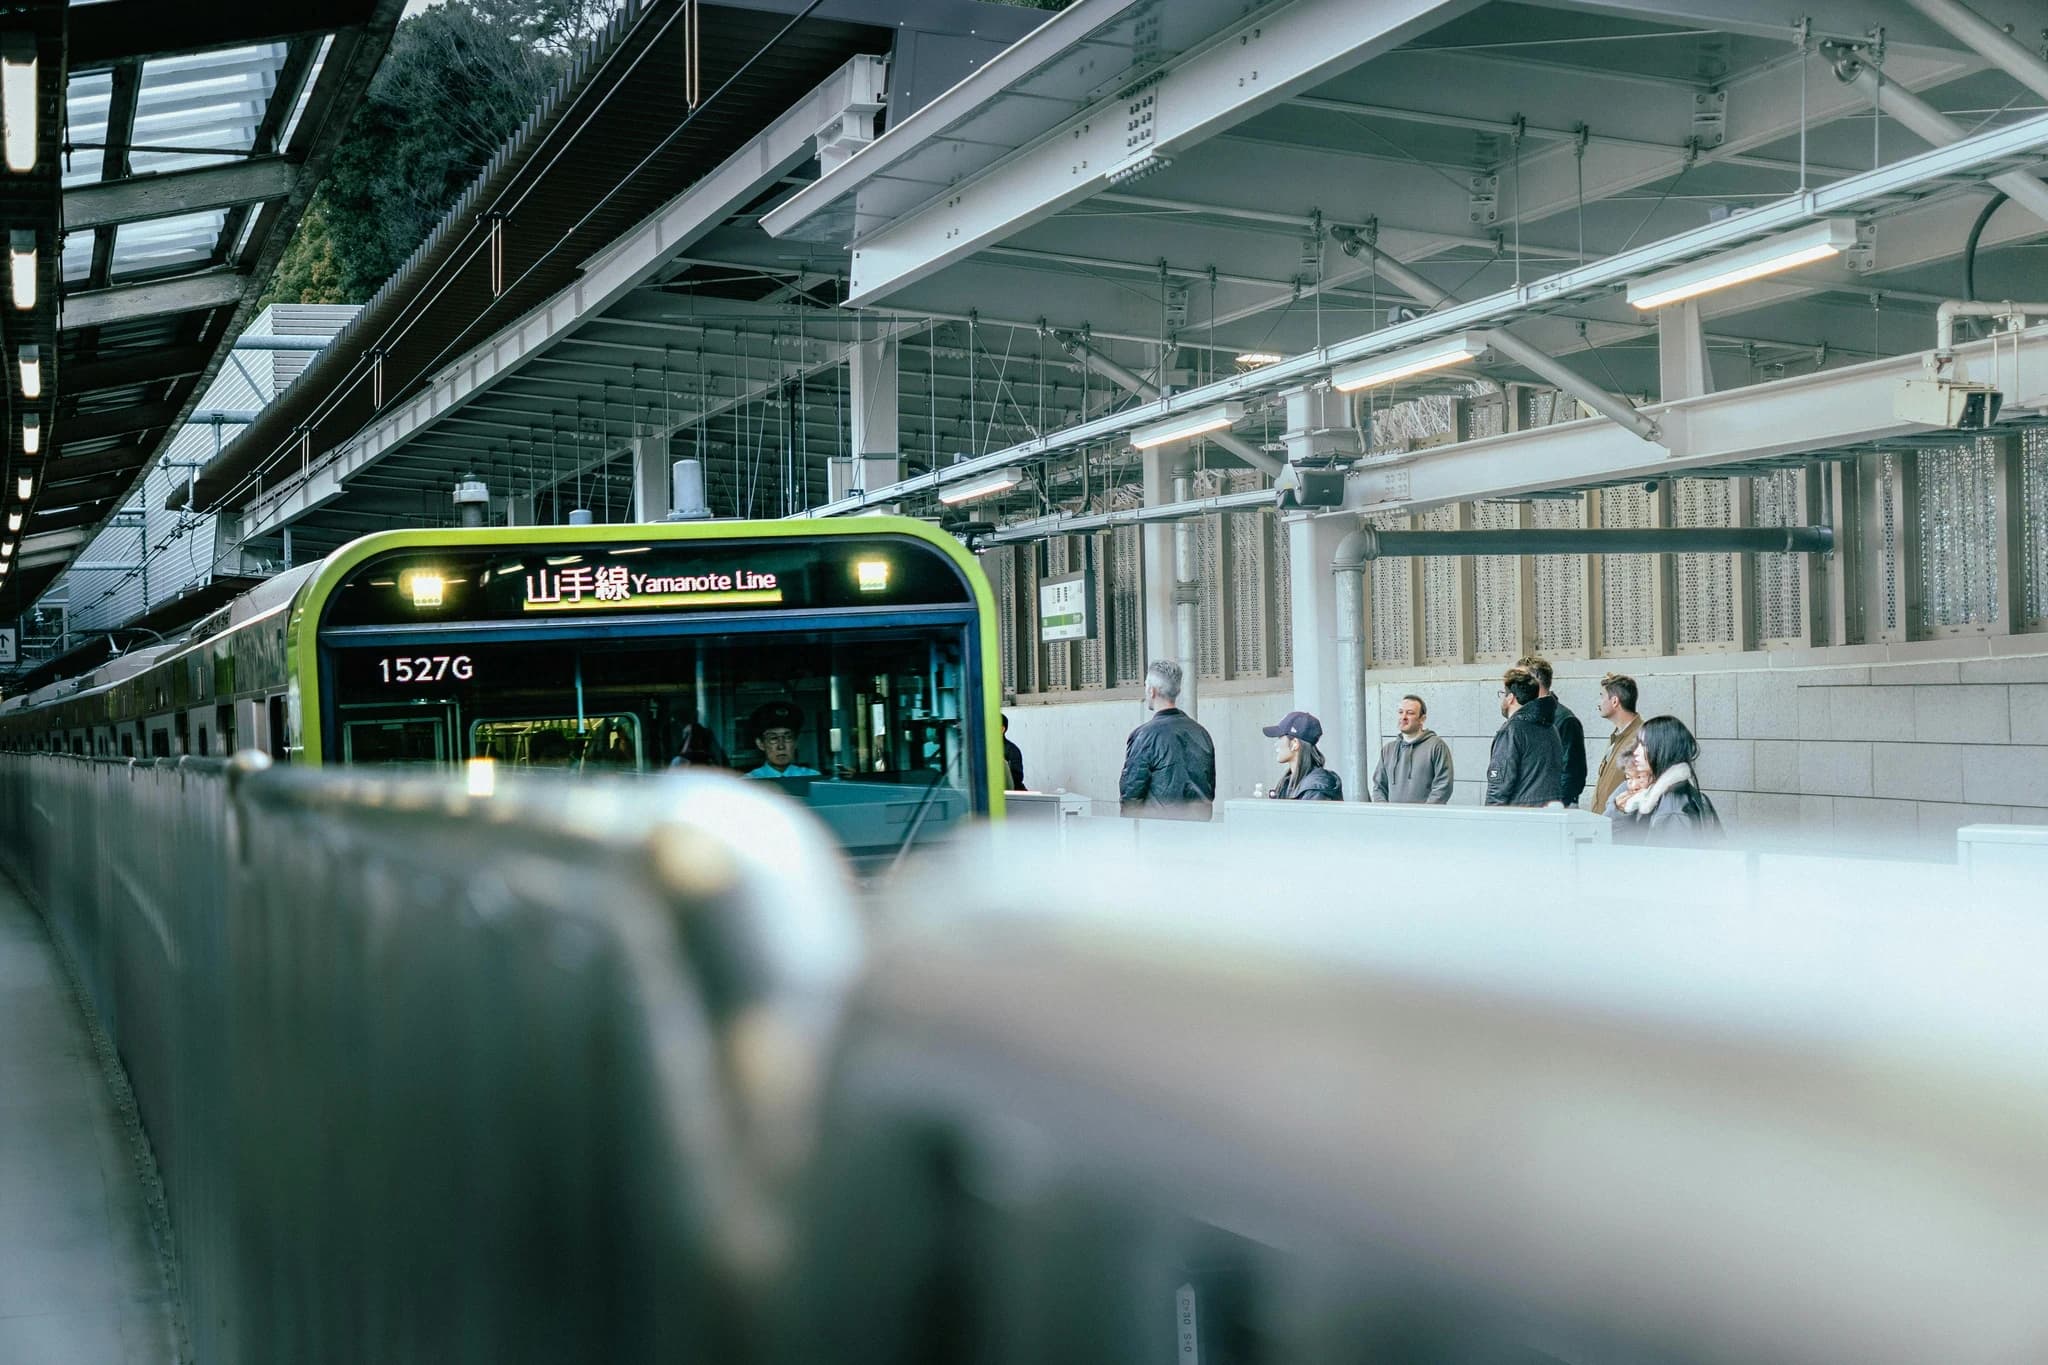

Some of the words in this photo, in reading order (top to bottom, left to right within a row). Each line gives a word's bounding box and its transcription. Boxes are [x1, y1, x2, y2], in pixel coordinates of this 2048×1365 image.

[526, 566, 630, 603] 山手線
[631, 573, 732, 593] Yamanote
[736, 570, 776, 590] Line
[379, 656, 473, 683] 1527G
